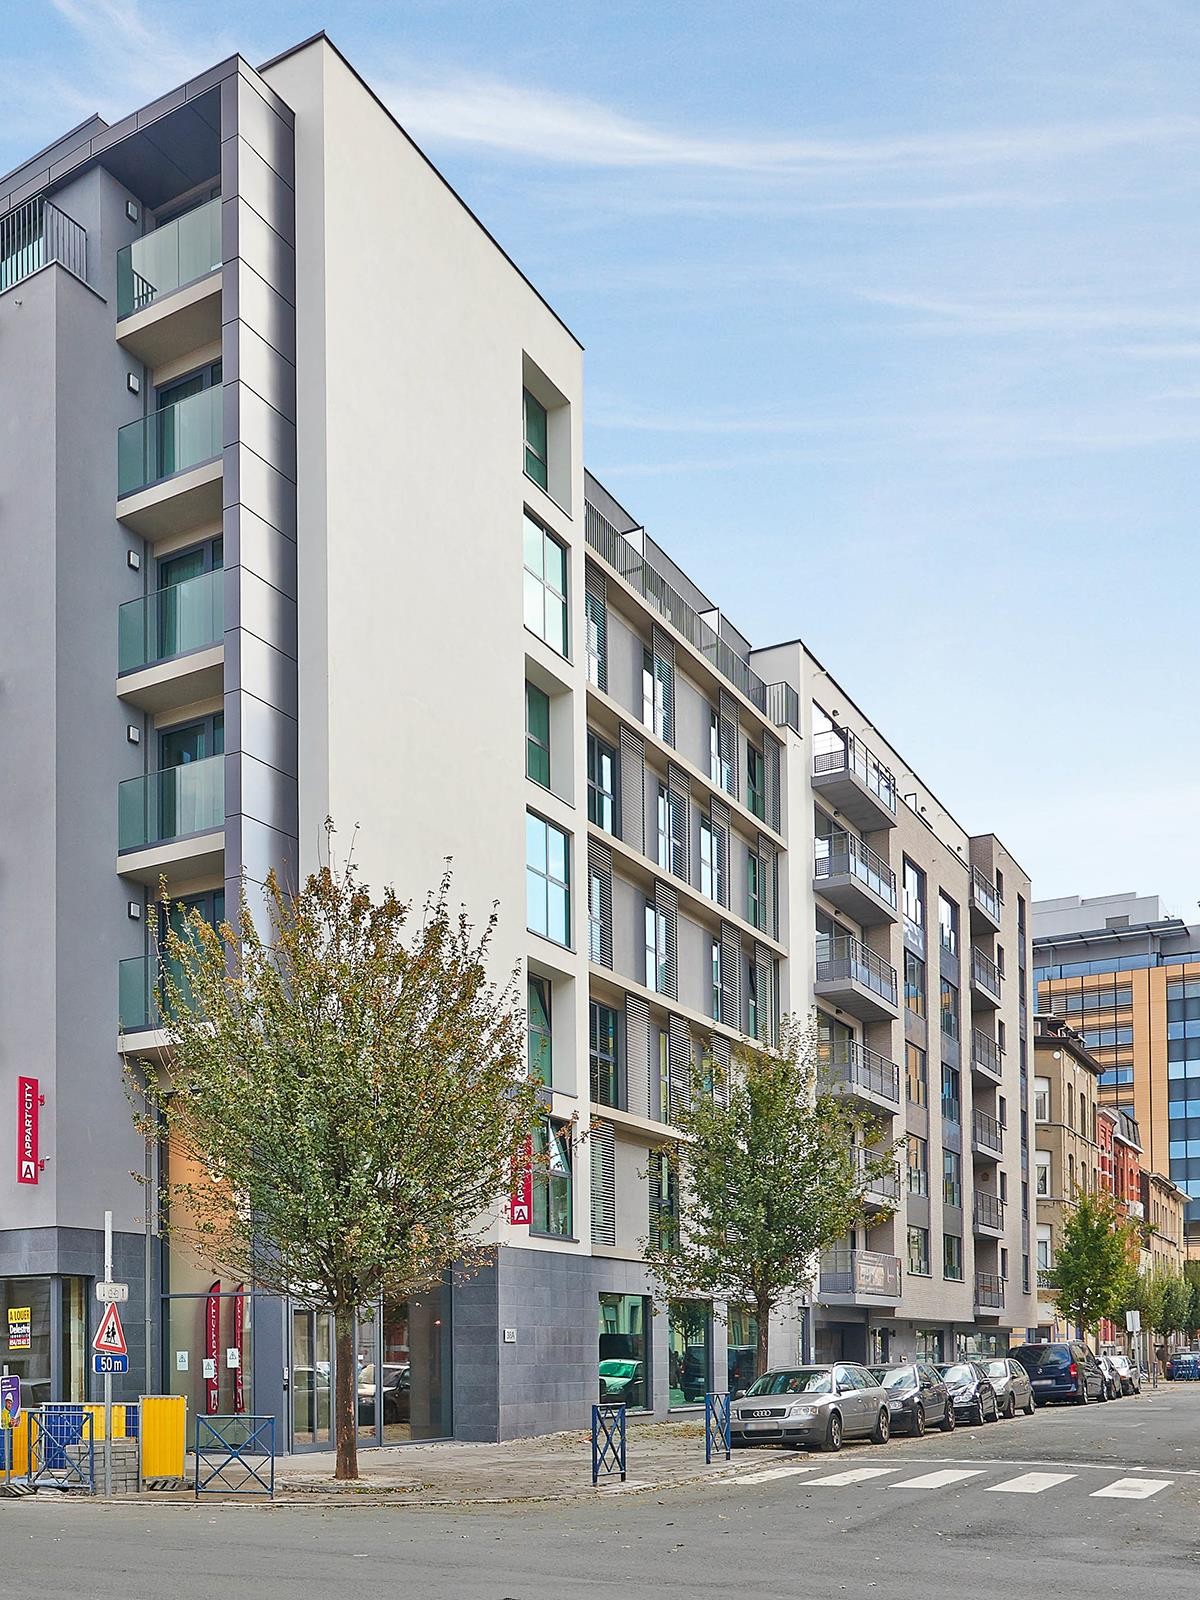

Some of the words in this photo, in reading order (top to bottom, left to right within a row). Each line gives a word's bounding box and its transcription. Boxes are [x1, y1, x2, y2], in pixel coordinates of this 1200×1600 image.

[24, 1083, 33, 1158] APPART'CITY
[14, 1309, 30, 1321] LOUER
[101, 1356, 113, 1371] 50
[113, 1360, 122, 1371] m
